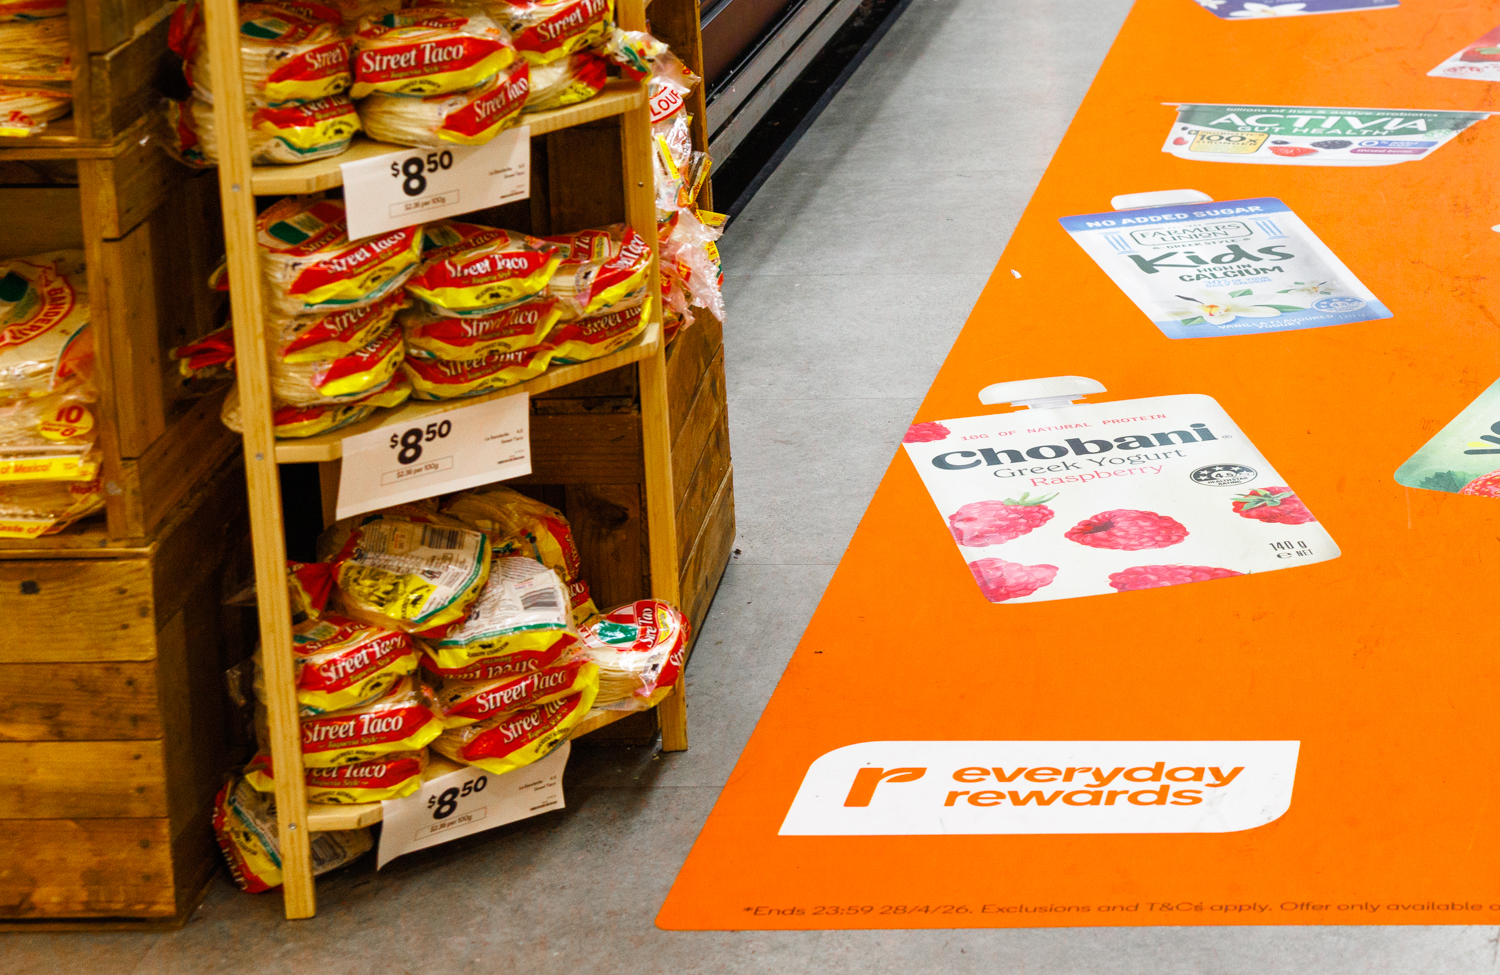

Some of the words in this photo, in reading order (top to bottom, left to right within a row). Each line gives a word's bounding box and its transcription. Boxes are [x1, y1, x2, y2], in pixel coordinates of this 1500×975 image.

[537, 10, 584, 42] Street
[361, 46, 415, 73] Street
[420, 42, 464, 65] Taco
[474, 92, 508, 123] Street
[1209, 113, 1428, 132] ACTIVIA
[1236, 125, 1279, 134] GUT
[1086, 219, 1116, 228] NO
[1122, 212, 1189, 225] ADDED
[1192, 205, 1263, 218] SUGAR
[1140, 222, 1241, 239] FARMERS
[1160, 230, 1229, 242] UNION
[319, 244, 371, 275] Street
[369, 230, 406, 257] Taco
[1127, 244, 1295, 274] Kids
[445, 258, 491, 279] Street
[490, 254, 528, 272] Taco
[1178, 266, 1285, 282] CALCIUM
[1197, 265, 1235, 273] HIGH
[960, 433, 990, 441] 10G
[997, 429, 1019, 437] OF
[1025, 421, 1092, 435] NATURAL
[1102, 413, 1167, 427] PROTEIN
[931, 422, 1219, 471] Chobani
[992, 458, 1083, 480] Greek
[1086, 448, 1187, 471] Yogurt
[1030, 464, 1163, 488] Raspberry
[1269, 540, 1294, 552] 140
[1295, 549, 1313, 557] NET
[320, 645, 374, 685] Street
[372, 632, 406, 659] Taco
[475, 678, 528, 715] Street
[529, 667, 568, 692] Taco
[302, 719, 356, 744] Street
[359, 712, 403, 737] Taco
[952, 761, 1245, 788] everyday
[944, 785, 1203, 807] rewards
[812, 904, 874, 917] 23:59
[981, 902, 1091, 915] Exclusions
[1096, 902, 1139, 913] and
[1210, 901, 1273, 917] apply.
[1279, 900, 1332, 912] Offer
[1336, 901, 1381, 913] only
[1387, 900, 1483, 912] available
